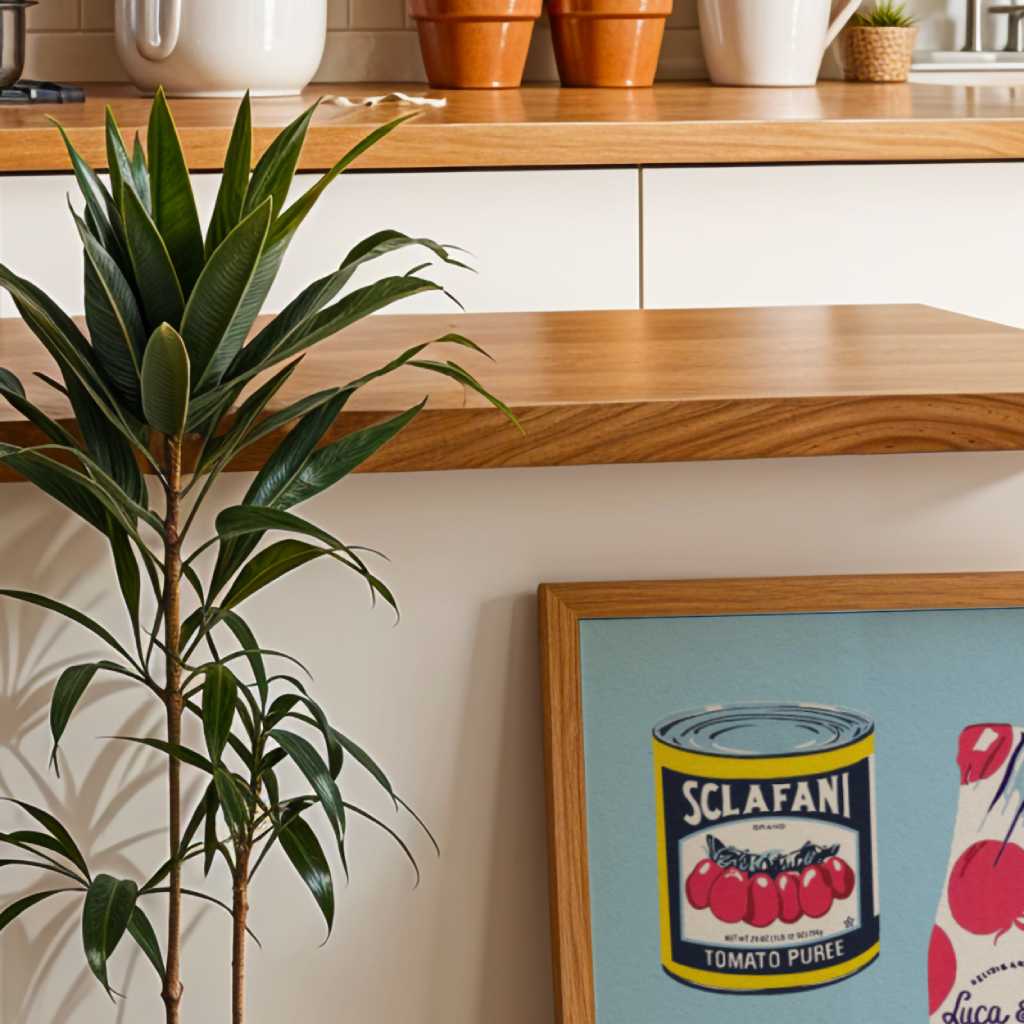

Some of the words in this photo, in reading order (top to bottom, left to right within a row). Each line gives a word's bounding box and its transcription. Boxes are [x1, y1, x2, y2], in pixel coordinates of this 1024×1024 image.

[682, 772, 851, 826] SCLAFANI
[704, 948, 780, 970] TOMATO
[787, 938, 846, 967] PUREE
